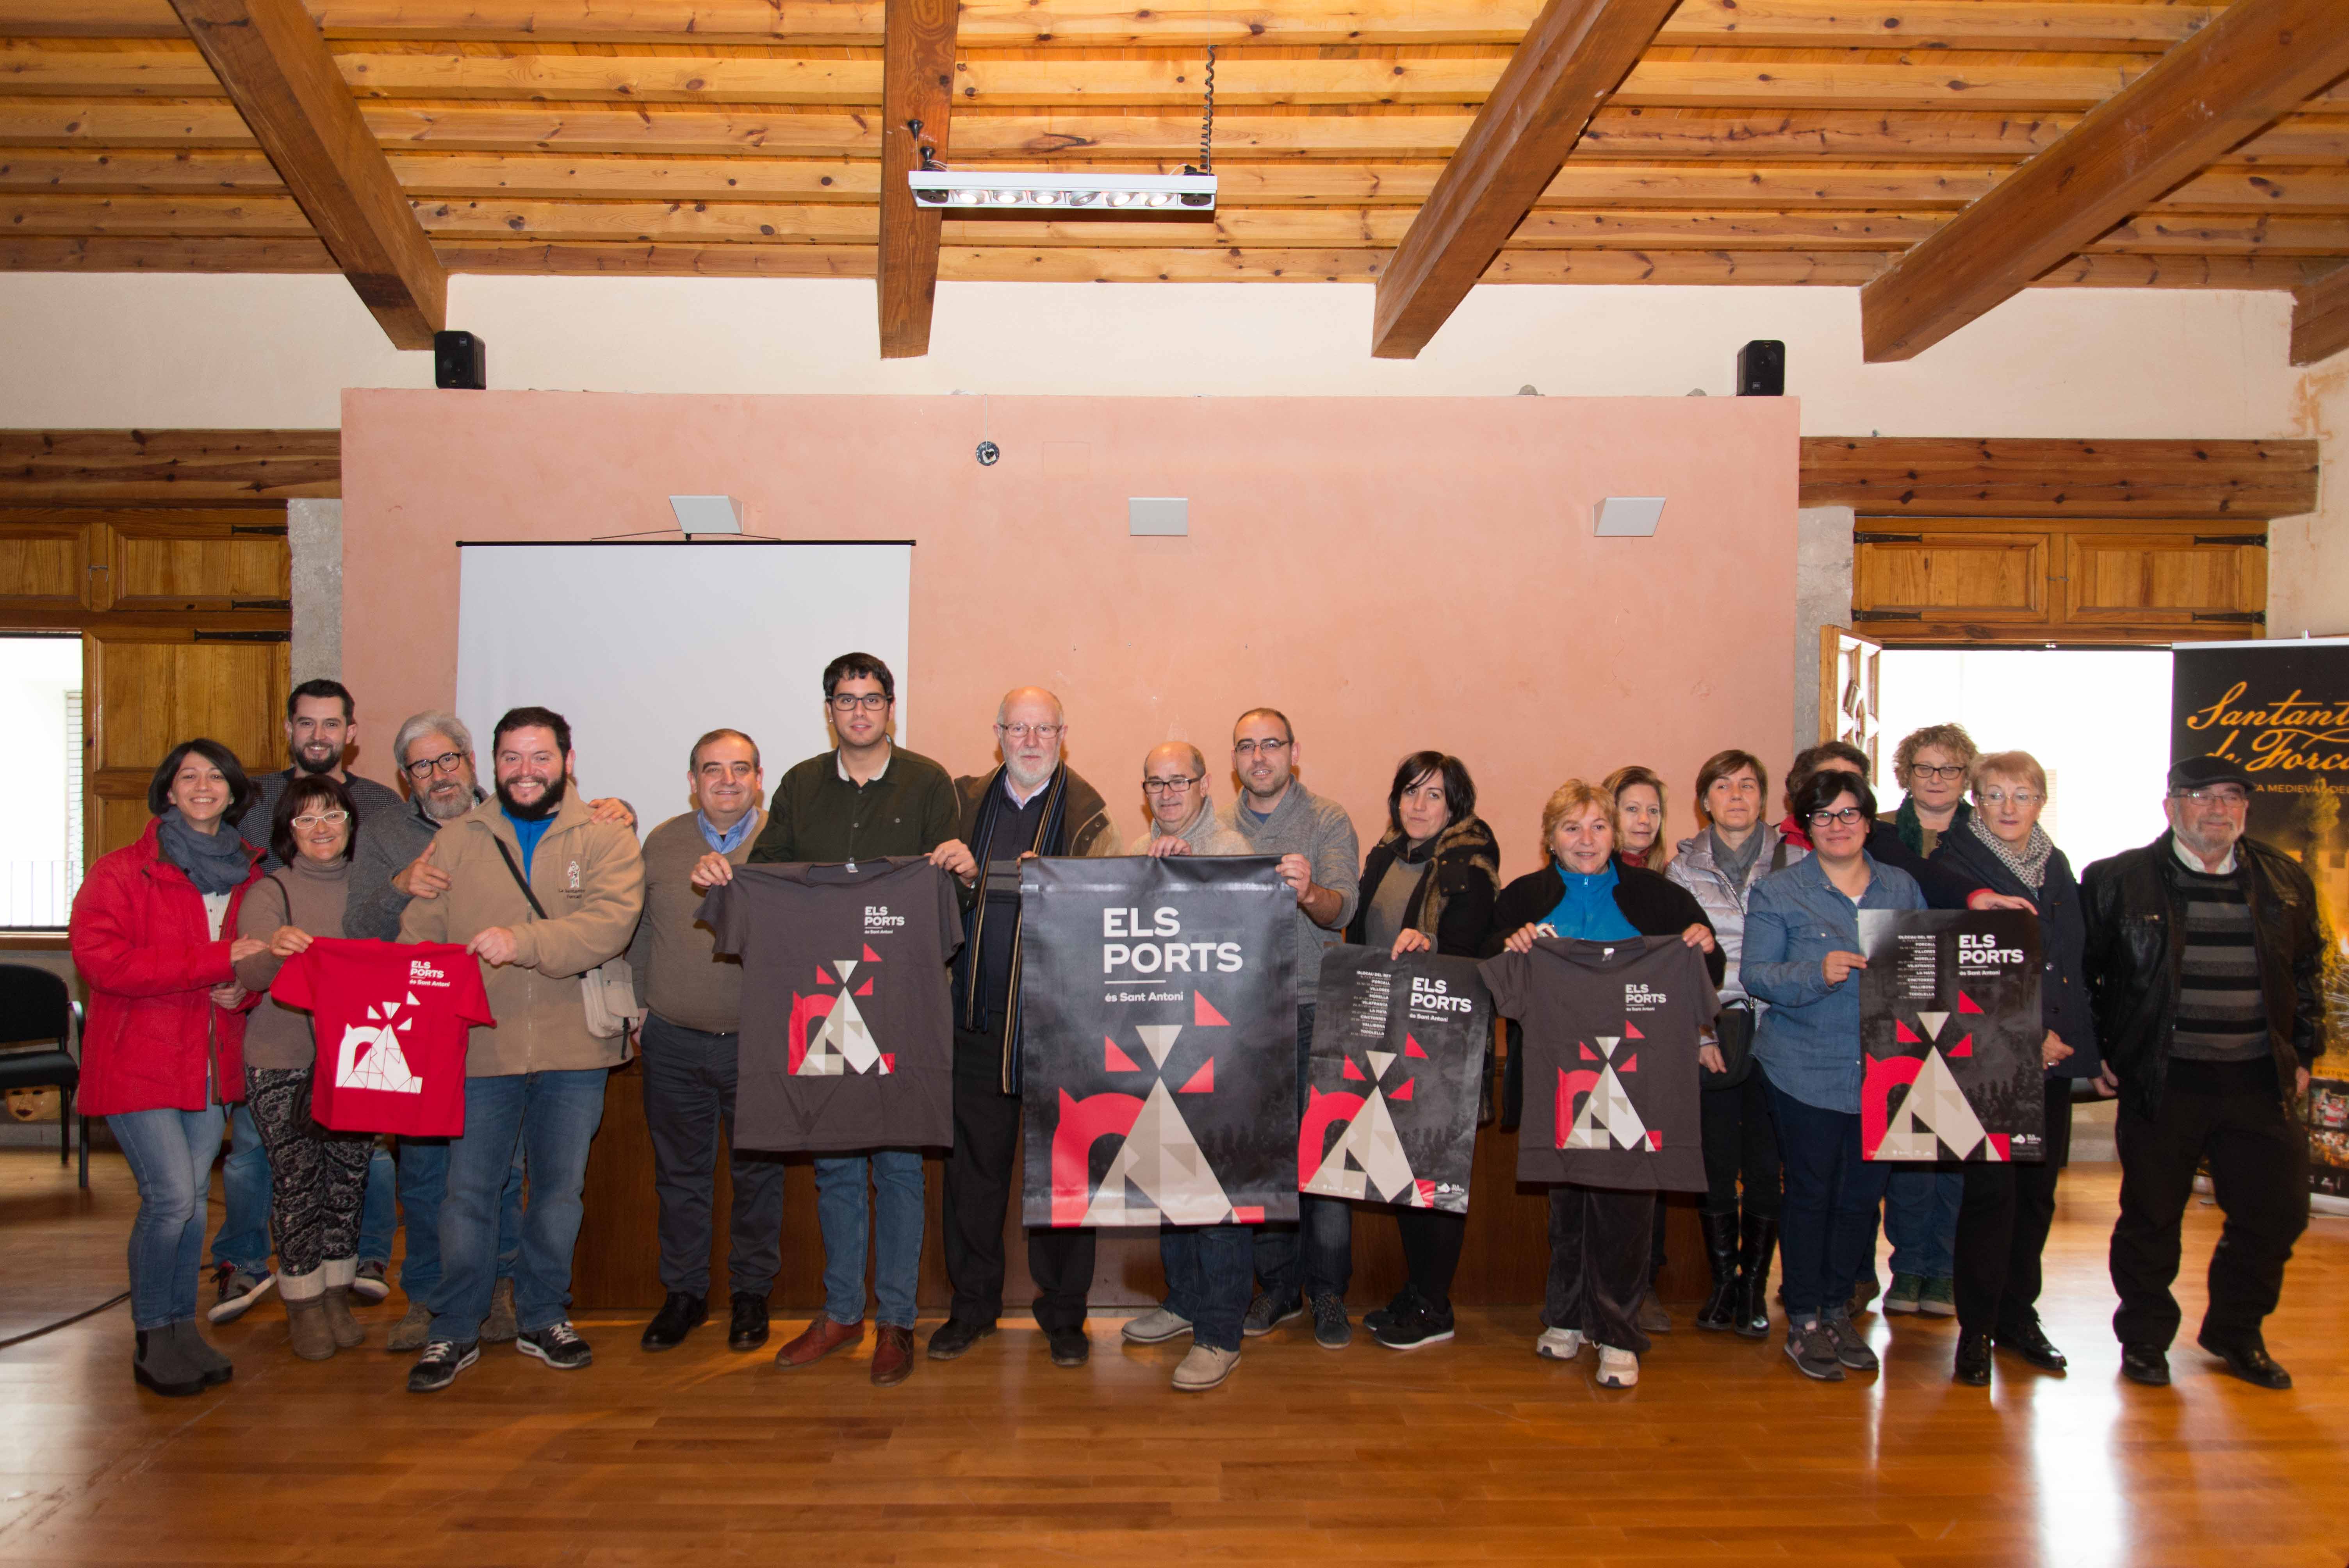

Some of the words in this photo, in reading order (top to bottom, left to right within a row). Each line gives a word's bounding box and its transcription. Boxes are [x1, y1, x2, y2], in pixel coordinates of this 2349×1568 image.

[865, 906, 888, 916] ELS
[864, 916, 905, 926] PORTS
[1103, 907, 1180, 937] ELS
[1959, 934, 1996, 948] ELS
[1103, 942, 1243, 973] PORTS
[1959, 949, 2024, 964] PORTS
[411, 960, 431, 969] ELS
[410, 968, 444, 978] PORTS
[1412, 976, 1447, 994] ELS
[1625, 984, 1649, 994] ELS
[1105, 993, 1117, 1002] és
[1120, 992, 1146, 1002] Sant
[1148, 991, 1183, 1001] Antoni
[1625, 993, 1667, 1003] PORTS
[1410, 992, 1472, 1013] PORTS
